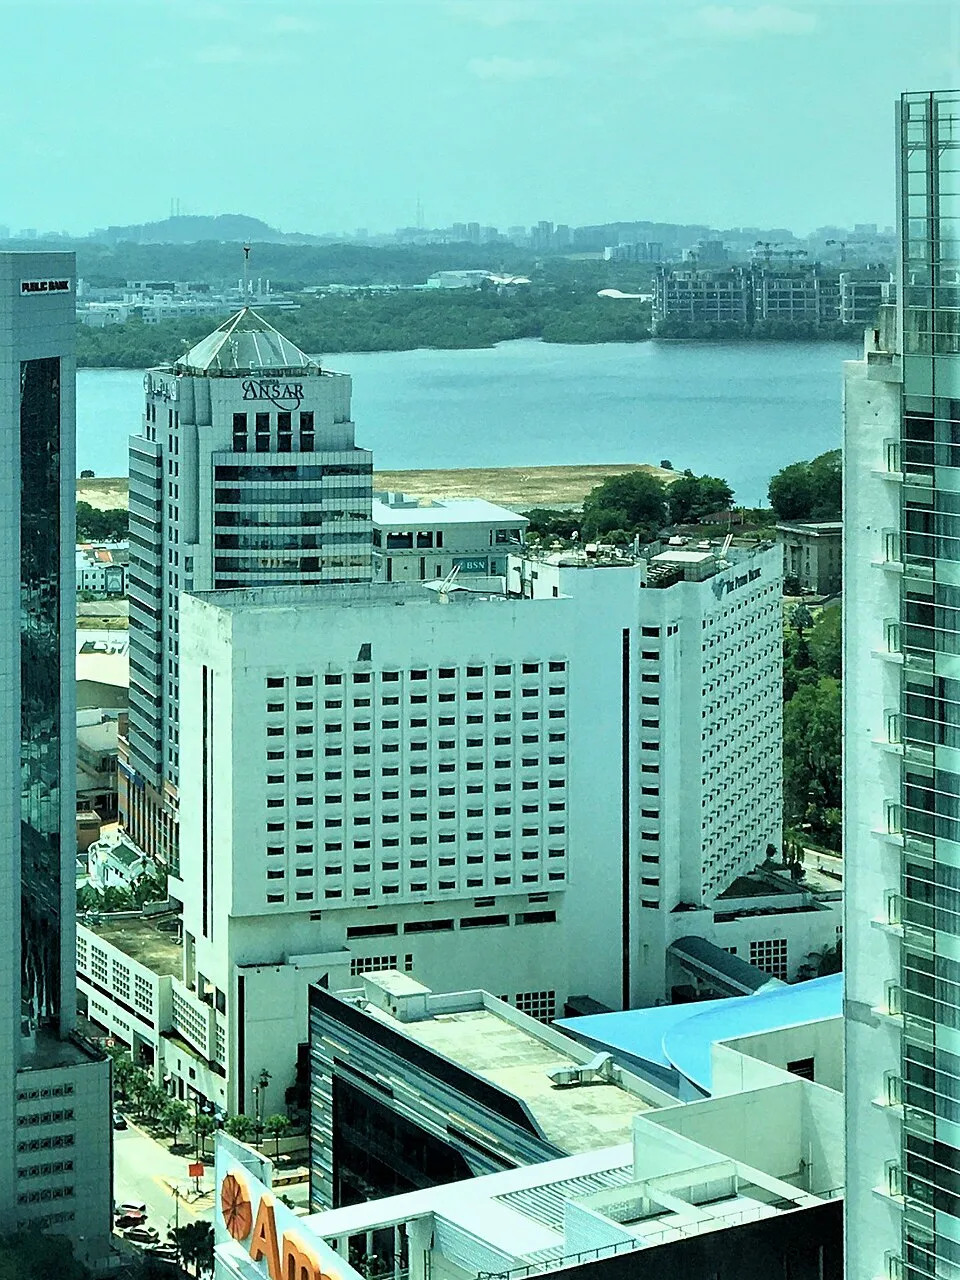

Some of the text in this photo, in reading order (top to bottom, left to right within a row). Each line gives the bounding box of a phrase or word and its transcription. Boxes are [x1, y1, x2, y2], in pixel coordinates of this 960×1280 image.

[21, 280, 68, 292] PUBLIC BANK
[241, 379, 305, 408] ANSAR
[466, 560, 486, 570] BSN
